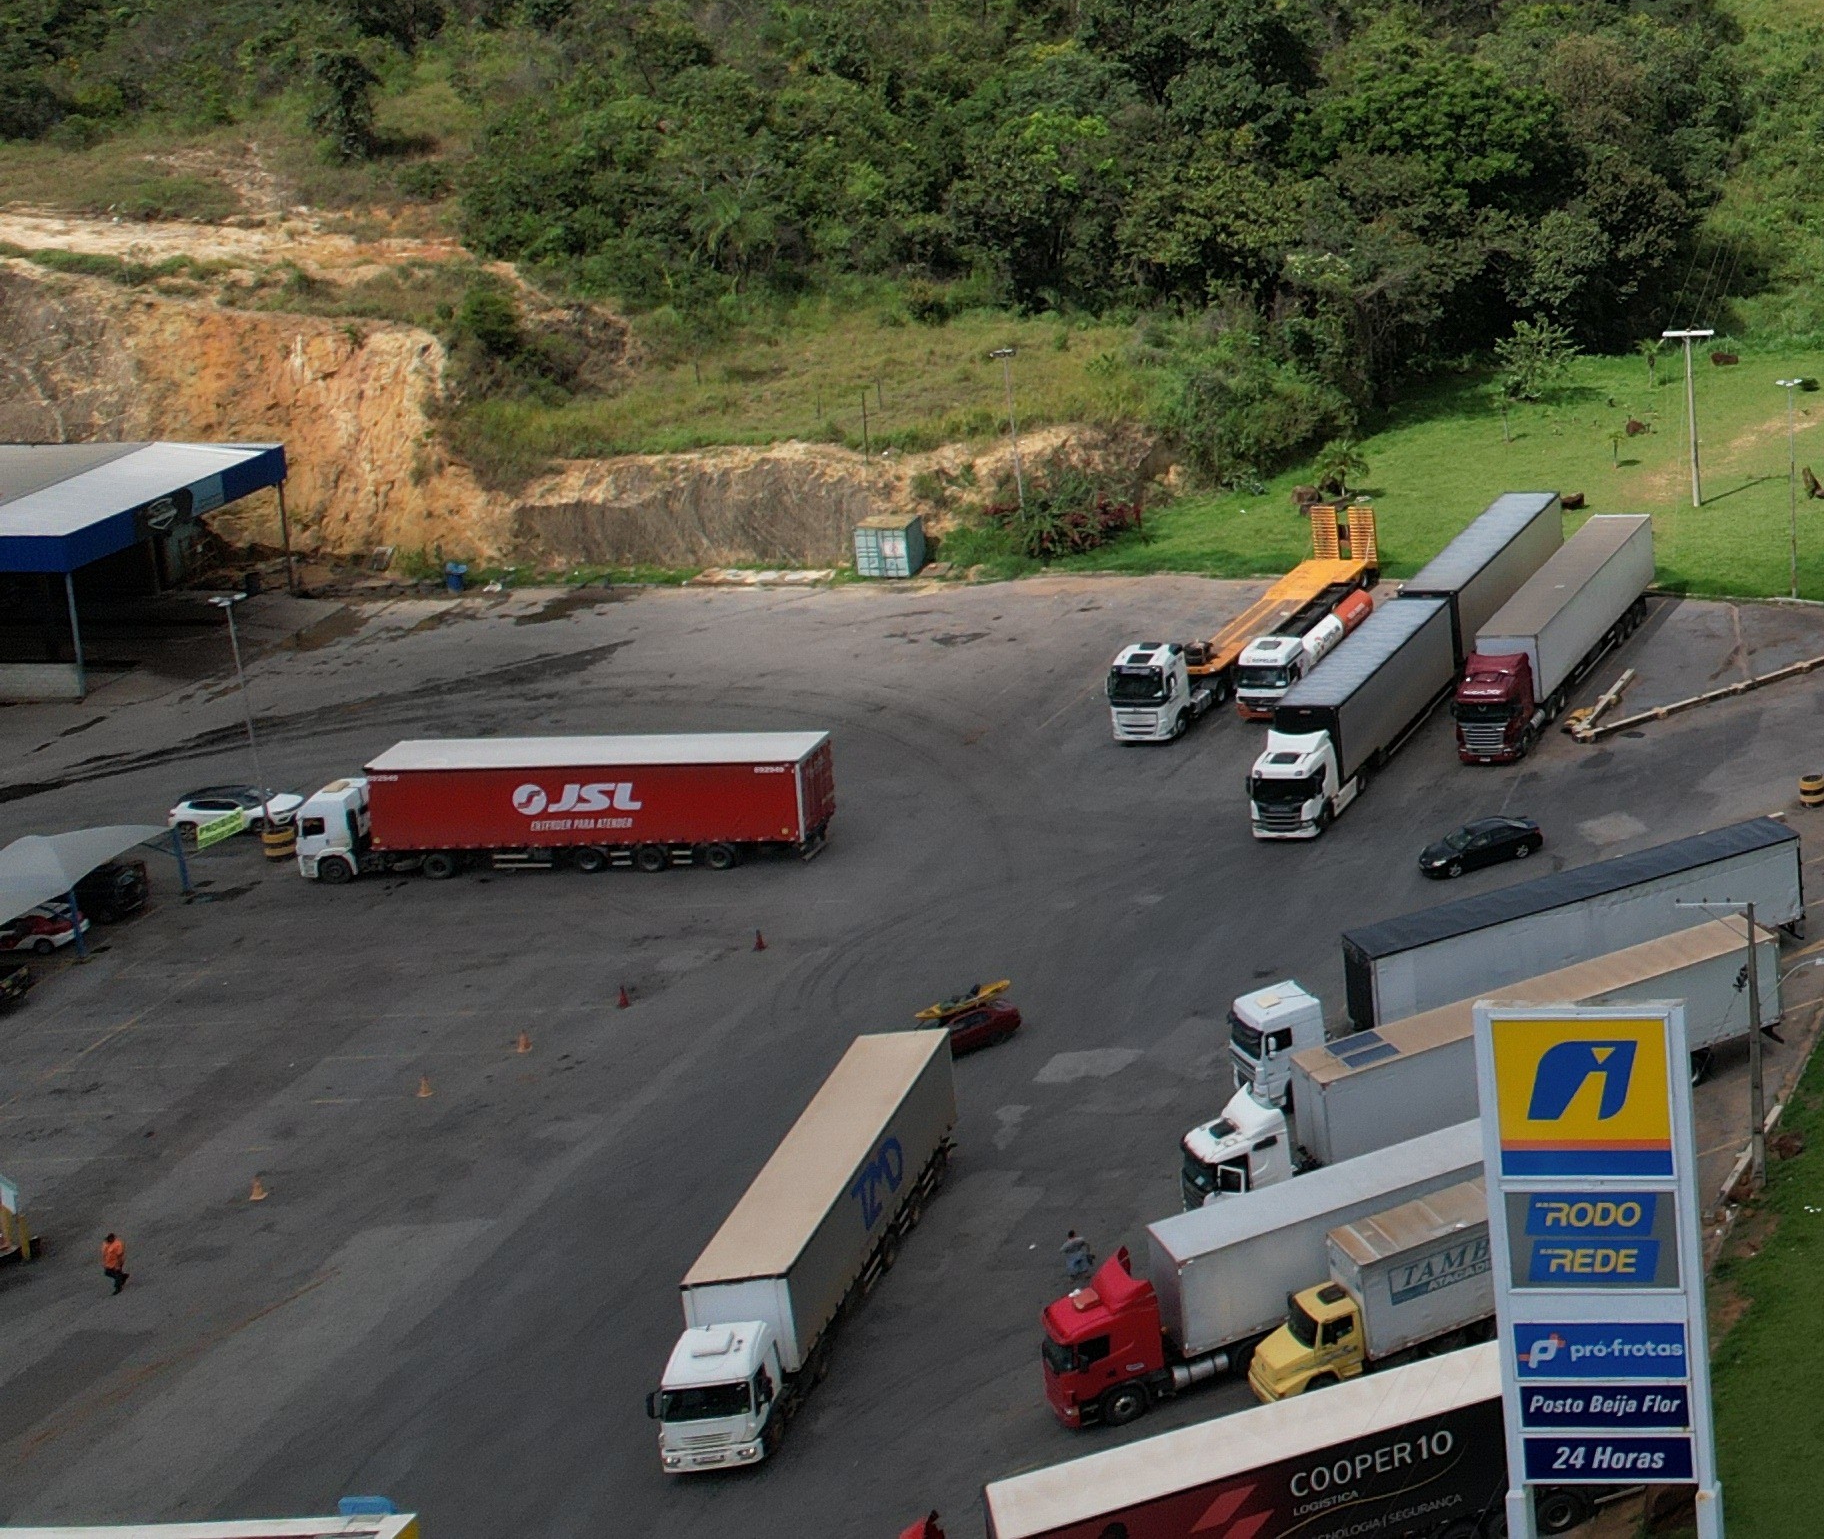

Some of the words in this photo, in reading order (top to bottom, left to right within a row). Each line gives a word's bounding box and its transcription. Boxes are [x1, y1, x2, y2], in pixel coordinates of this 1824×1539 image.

[547, 782, 642, 813] JSL
[1535, 1201, 1642, 1228] RODO
[1403, 1239, 1489, 1287] TAMB
[1539, 1248, 1639, 1273] REDE
[1529, 1395, 1585, 1413] Posto
[1588, 1395, 1637, 1417] Beija
[1642, 1394, 1681, 1413] Flor
[1552, 1446, 1586, 1469] 24
[1591, 1446, 1665, 1469] Horas
